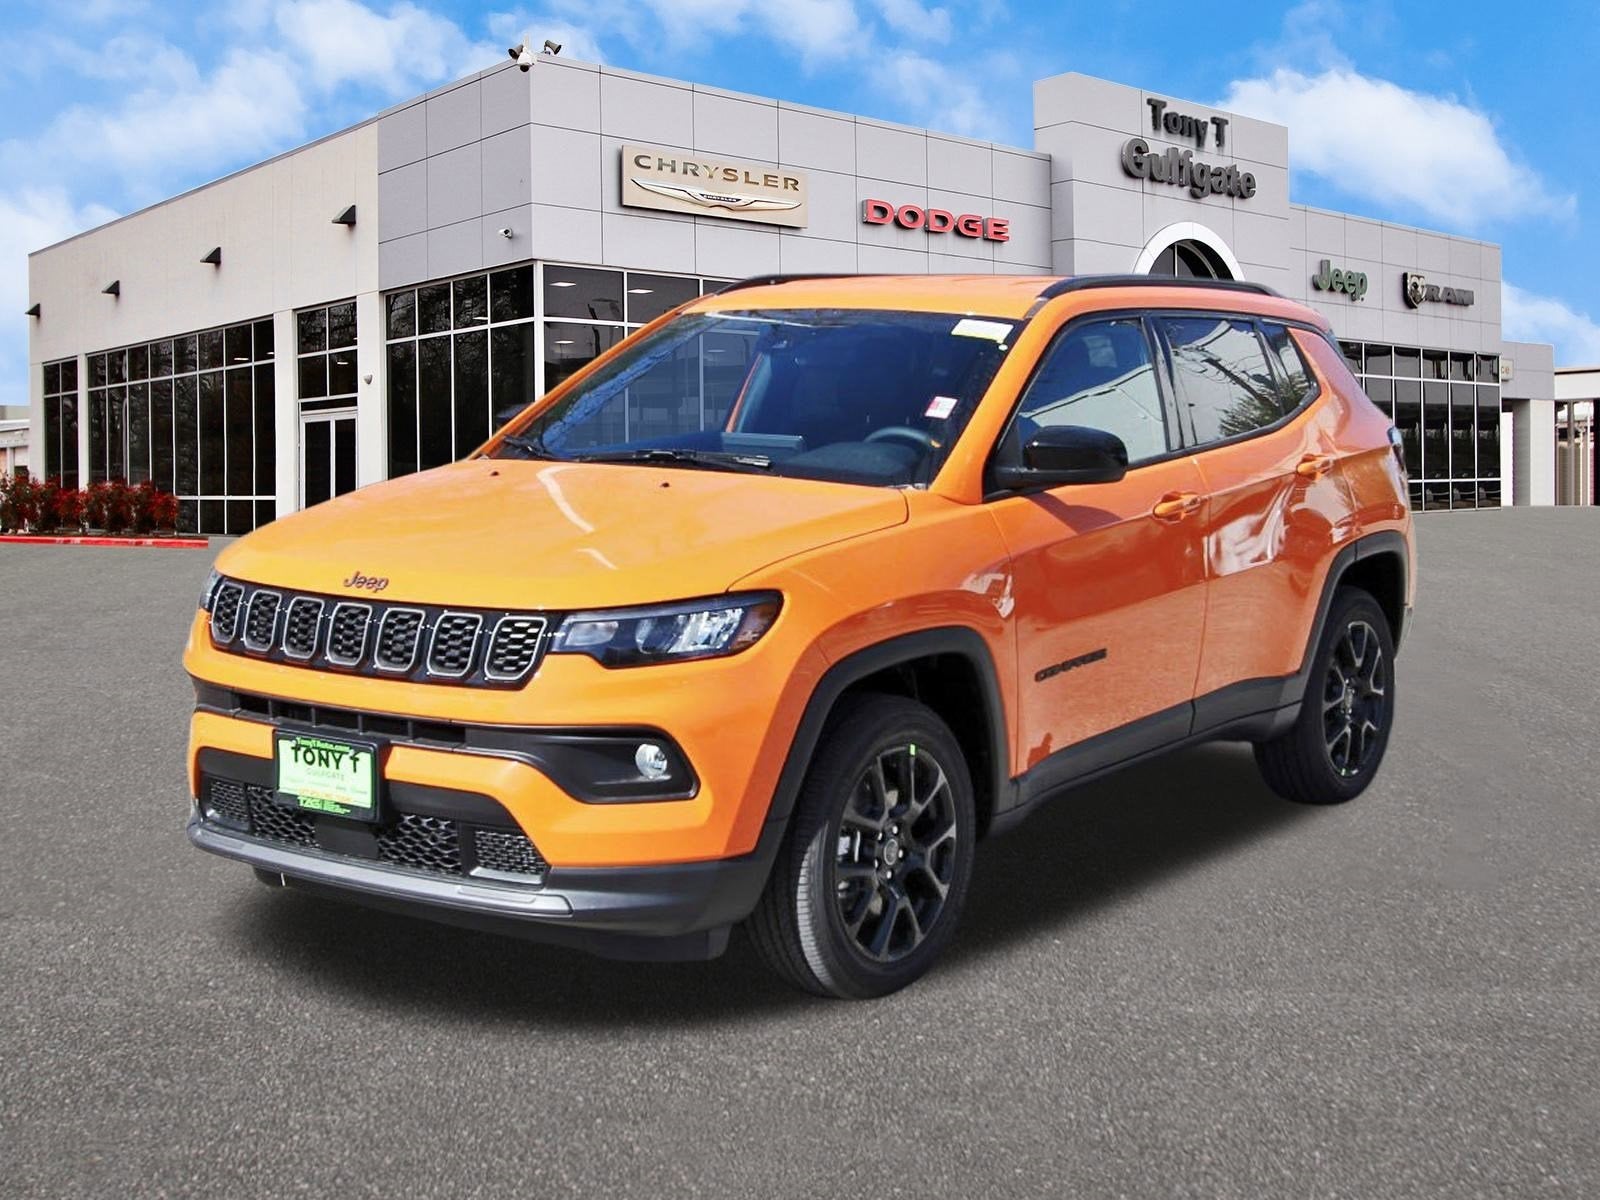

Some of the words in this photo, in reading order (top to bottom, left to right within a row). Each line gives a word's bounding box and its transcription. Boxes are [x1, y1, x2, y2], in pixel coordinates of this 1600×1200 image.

[1146, 98, 1208, 148] Tony
[1210, 117, 1229, 148] T
[633, 154, 800, 191] CHRYSLER
[1121, 138, 1256, 199] Gulfgate
[862, 198, 1010, 242] DODGE
[1312, 259, 1367, 301] Jeep
[1424, 284, 1475, 306] RAM
[343, 570, 389, 593] Jeep
[291, 744, 343, 770] TONY
